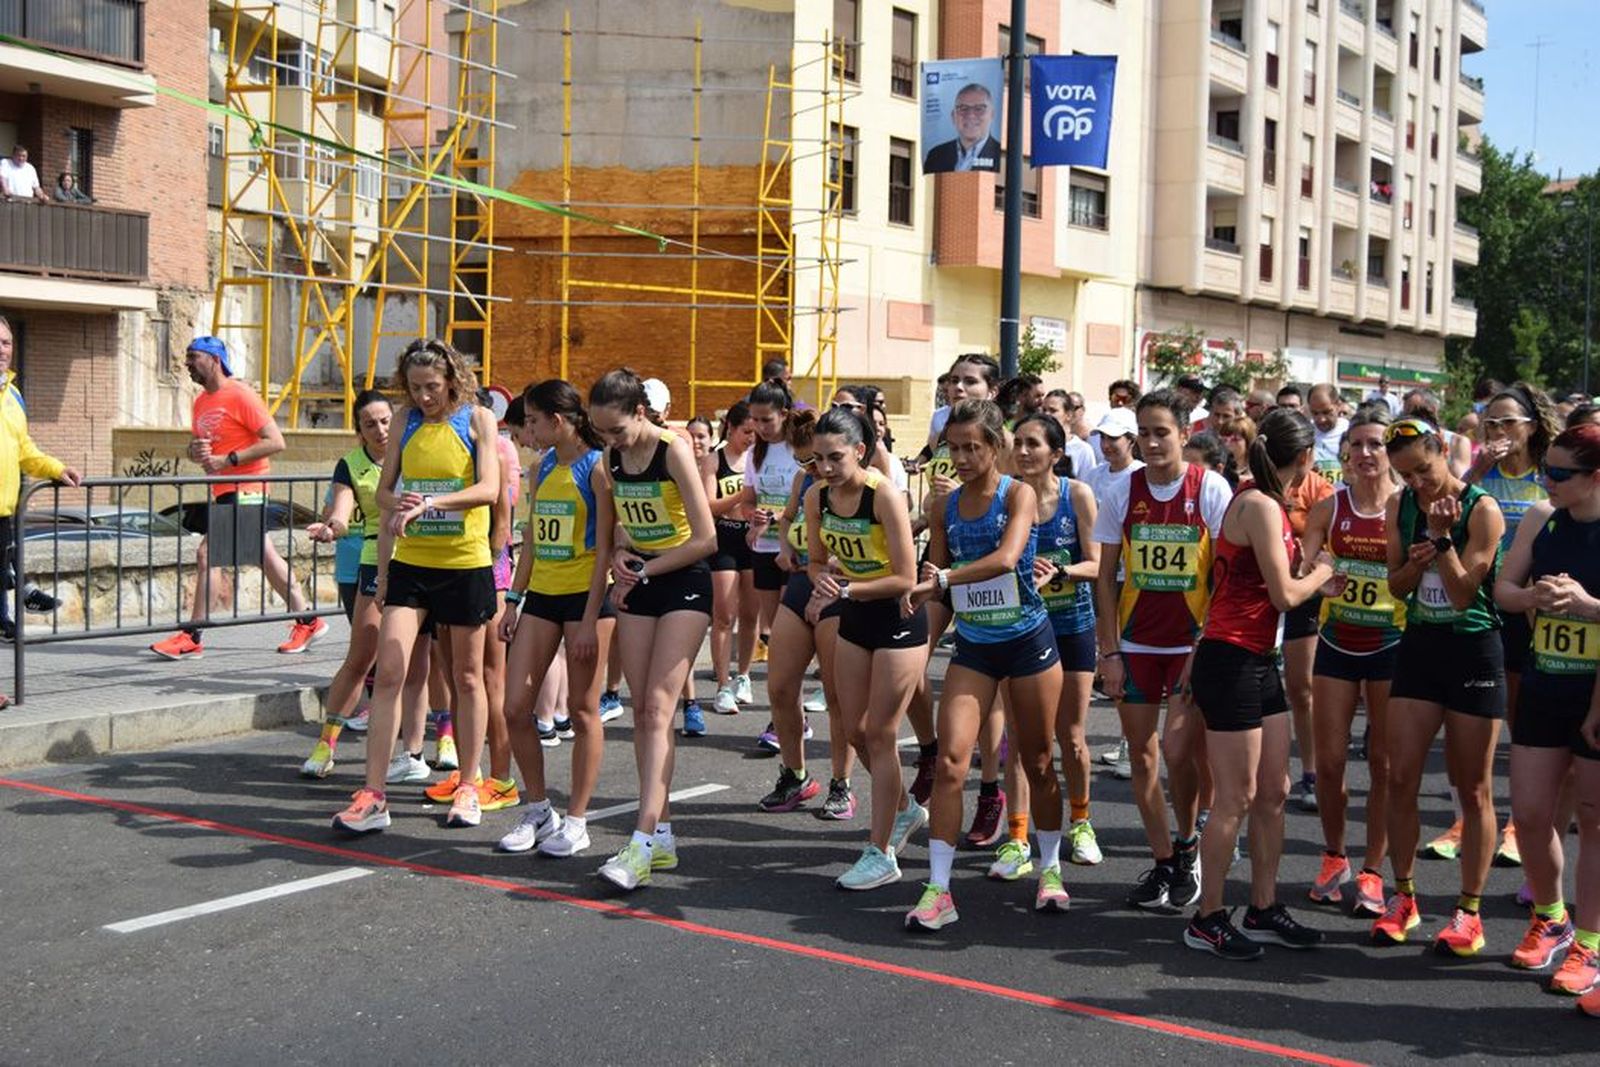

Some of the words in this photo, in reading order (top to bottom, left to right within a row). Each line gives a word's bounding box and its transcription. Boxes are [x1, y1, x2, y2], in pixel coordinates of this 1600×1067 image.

[1045, 85, 1096, 100] VOTA
[622, 501, 657, 524] 116
[538, 518, 560, 542] 30
[826, 534, 866, 558] 201
[1137, 544, 1187, 571] 184
[967, 589, 1005, 607] NOELIA
[1343, 579, 1377, 606] 36
[1542, 622, 1586, 654] 161
